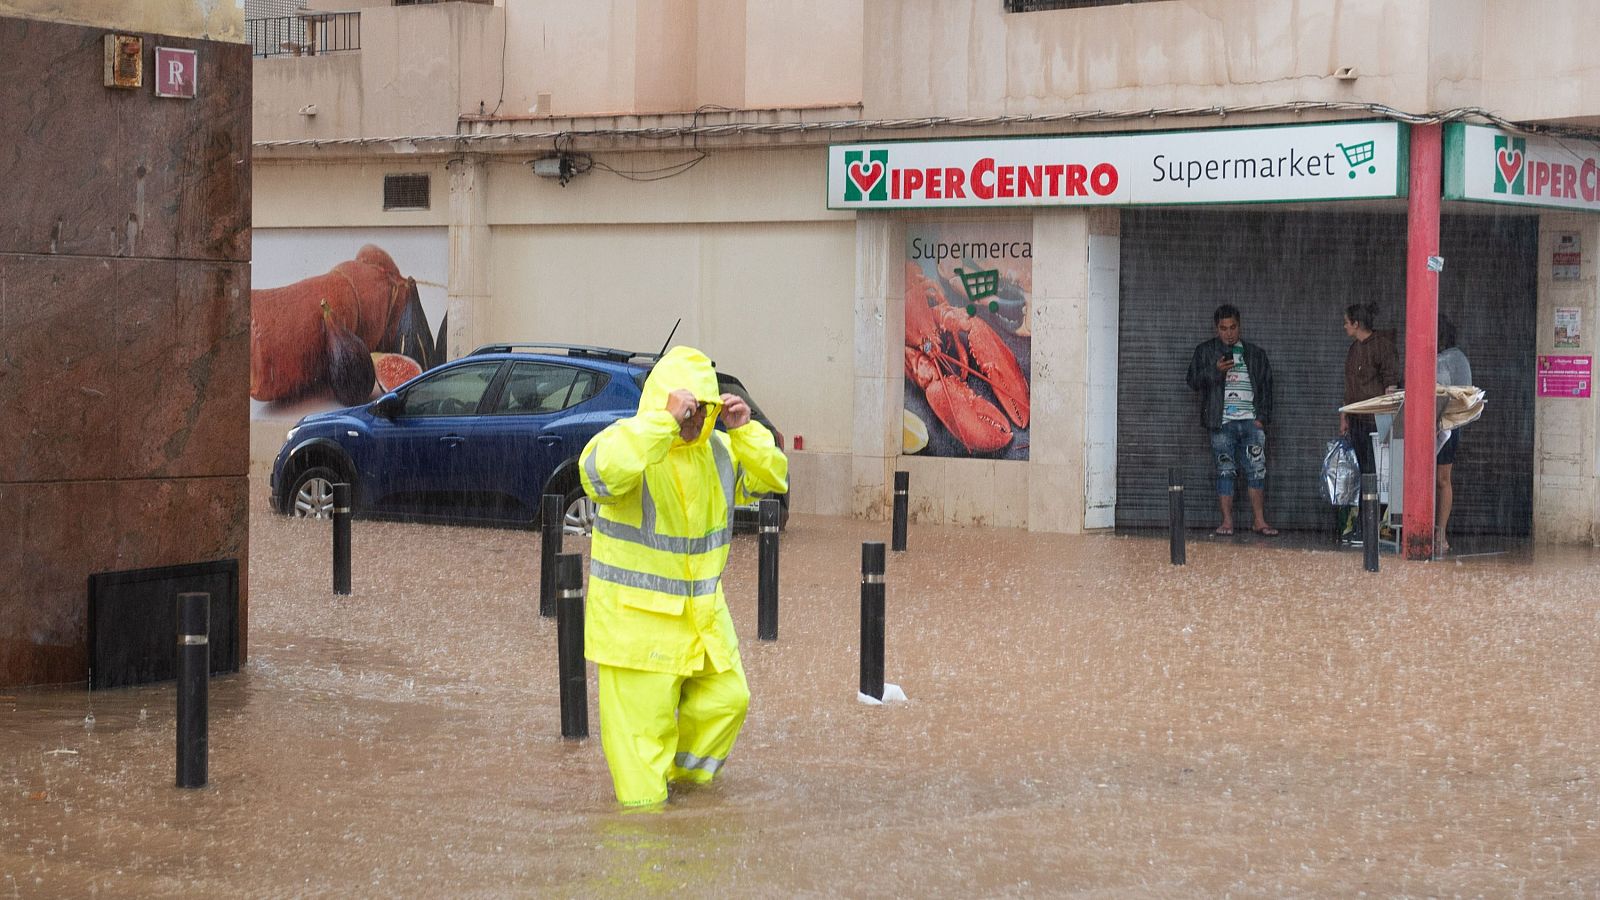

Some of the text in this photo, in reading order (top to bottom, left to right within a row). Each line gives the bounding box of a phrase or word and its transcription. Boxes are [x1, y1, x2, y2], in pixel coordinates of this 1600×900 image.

[168, 60, 184, 85] R
[1153, 148, 1335, 188] Supermarket
[912, 238, 1033, 264] Supermerca
